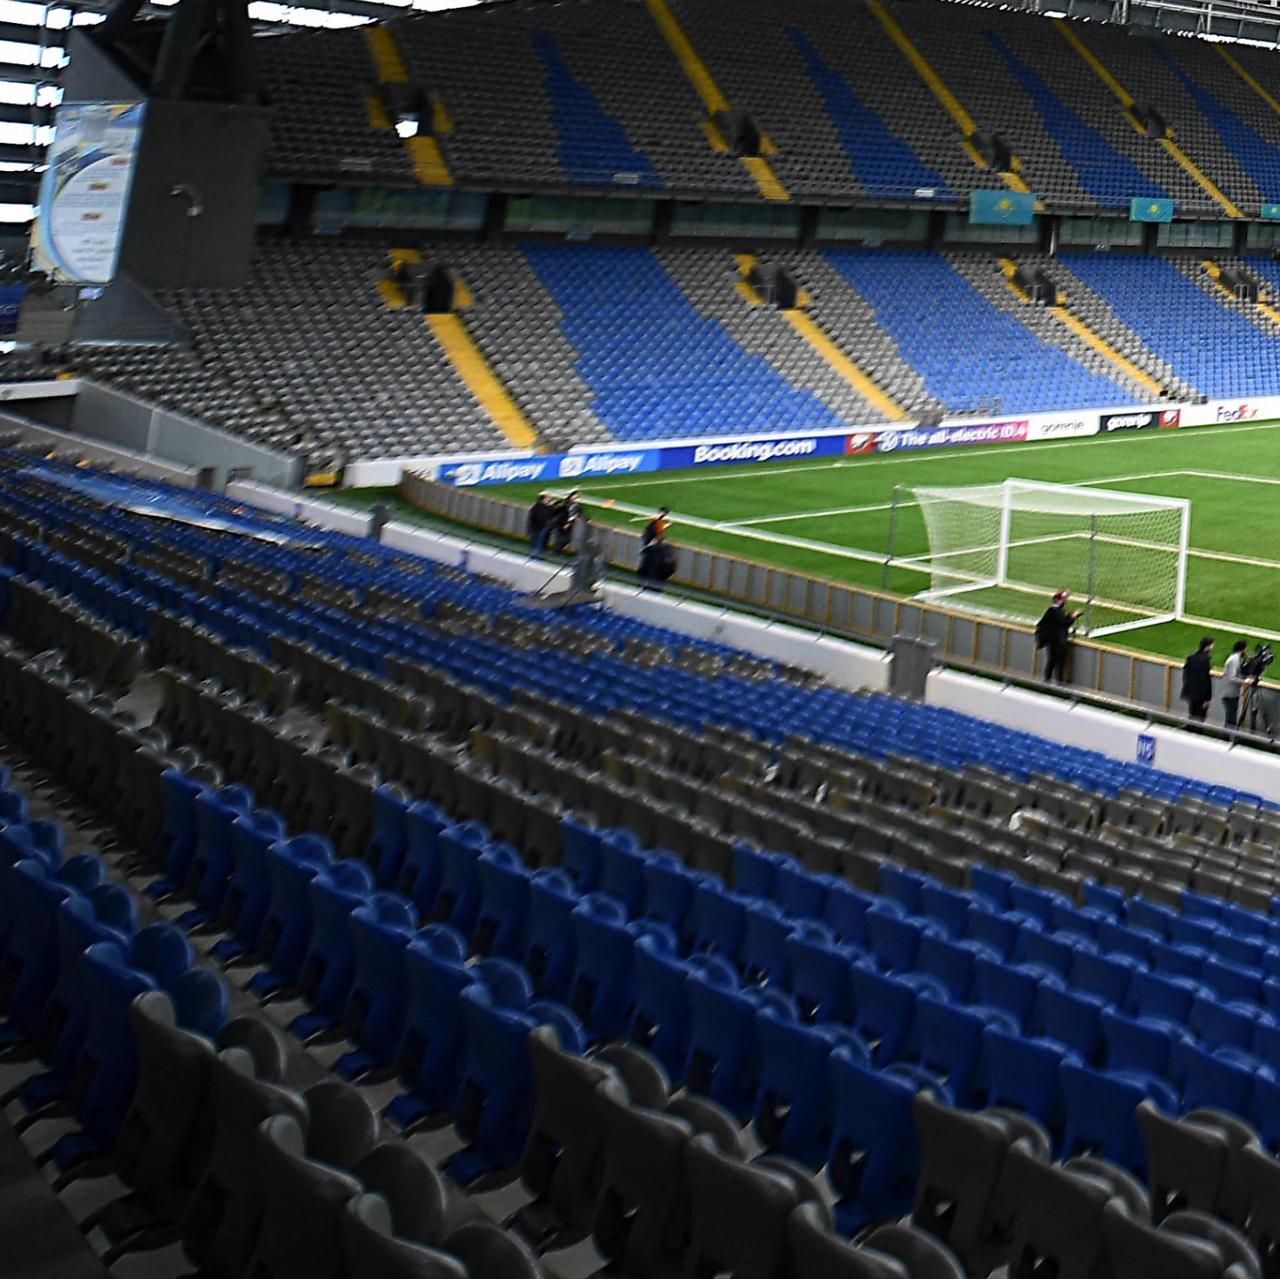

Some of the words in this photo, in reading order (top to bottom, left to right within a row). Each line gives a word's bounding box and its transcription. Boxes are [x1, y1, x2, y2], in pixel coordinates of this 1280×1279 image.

[1216, 404, 1258, 422] FedEx
[1041, 422, 1085, 435] gorenje
[902, 431, 926, 447] The
[694, 438, 817, 463] Booking.com
[481, 463, 546, 482] Alipay
[585, 454, 645, 473] Alipay
